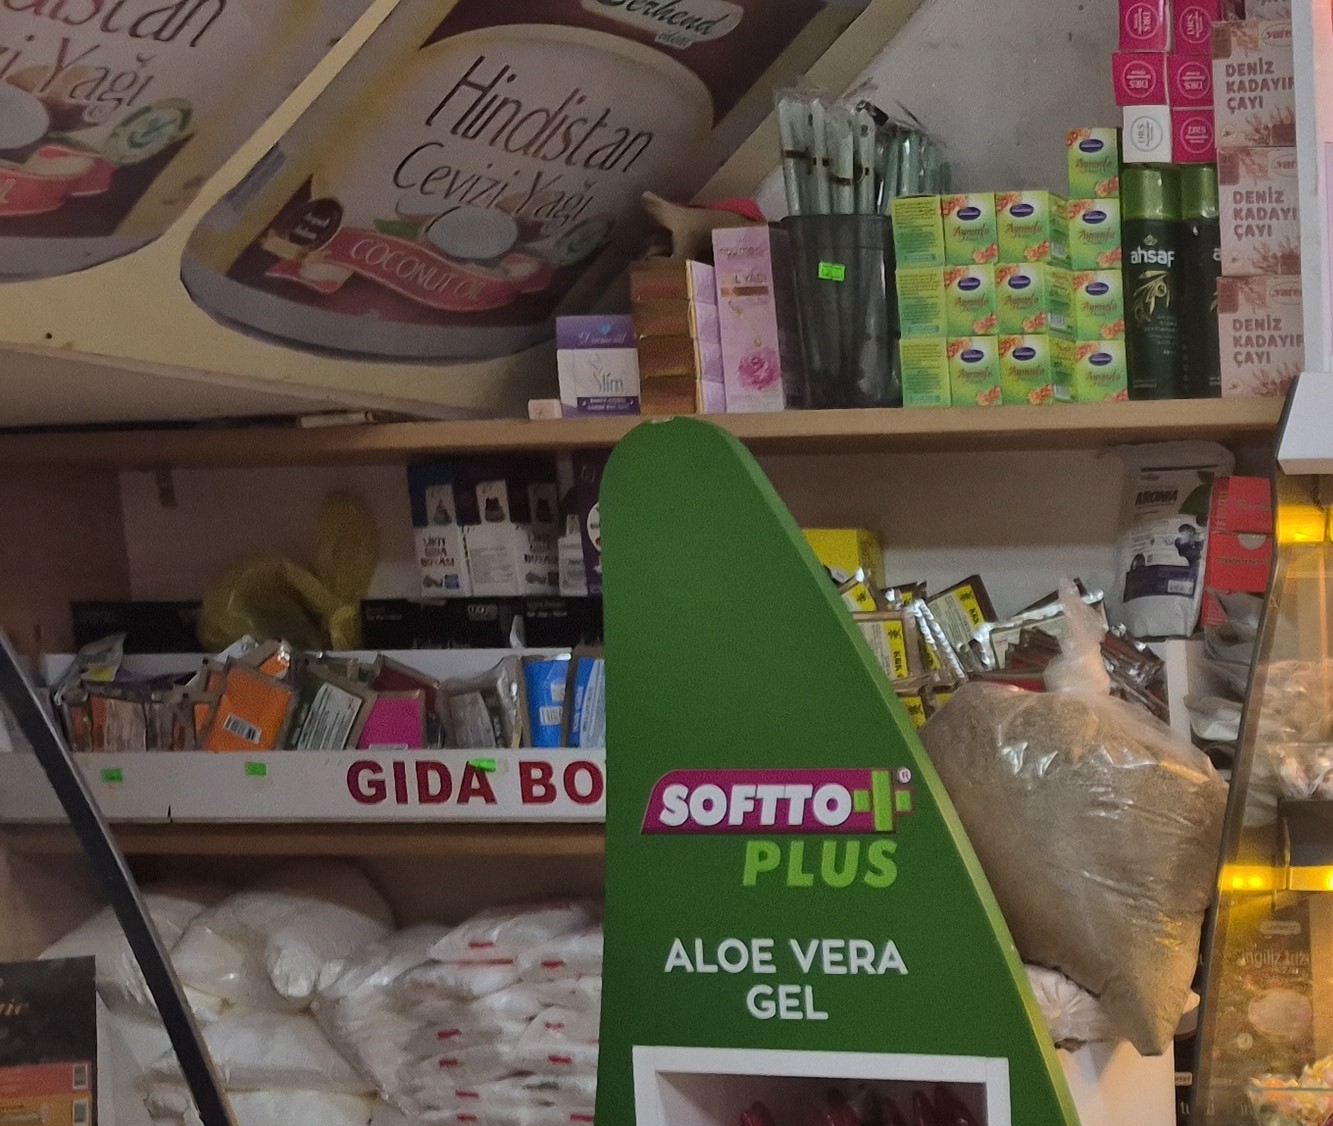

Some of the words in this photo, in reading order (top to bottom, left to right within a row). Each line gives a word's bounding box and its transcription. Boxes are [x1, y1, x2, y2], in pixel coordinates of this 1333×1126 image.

[1225, 57, 1274, 78] DENİZ
[425, 55, 654, 174] Hindistan
[1226, 96, 1264, 114] ÇAYI
[393, 141, 520, 209] Cevizi
[1232, 186, 1284, 204] DENİZ
[1233, 207, 1298, 221] KADAYI
[1233, 223, 1272, 240] ÇAYI
[350, 237, 451, 295] COCONUT
[1232, 314, 1282, 332] DENİZ
[1233, 351, 1272, 368] ÇAYI
[346, 760, 497, 807] GIDA
[741, 839, 899, 889] PLUS
[663, 936, 777, 975] ALOE
[789, 937, 909, 976] VERA
[746, 984, 829, 1021] GEL
